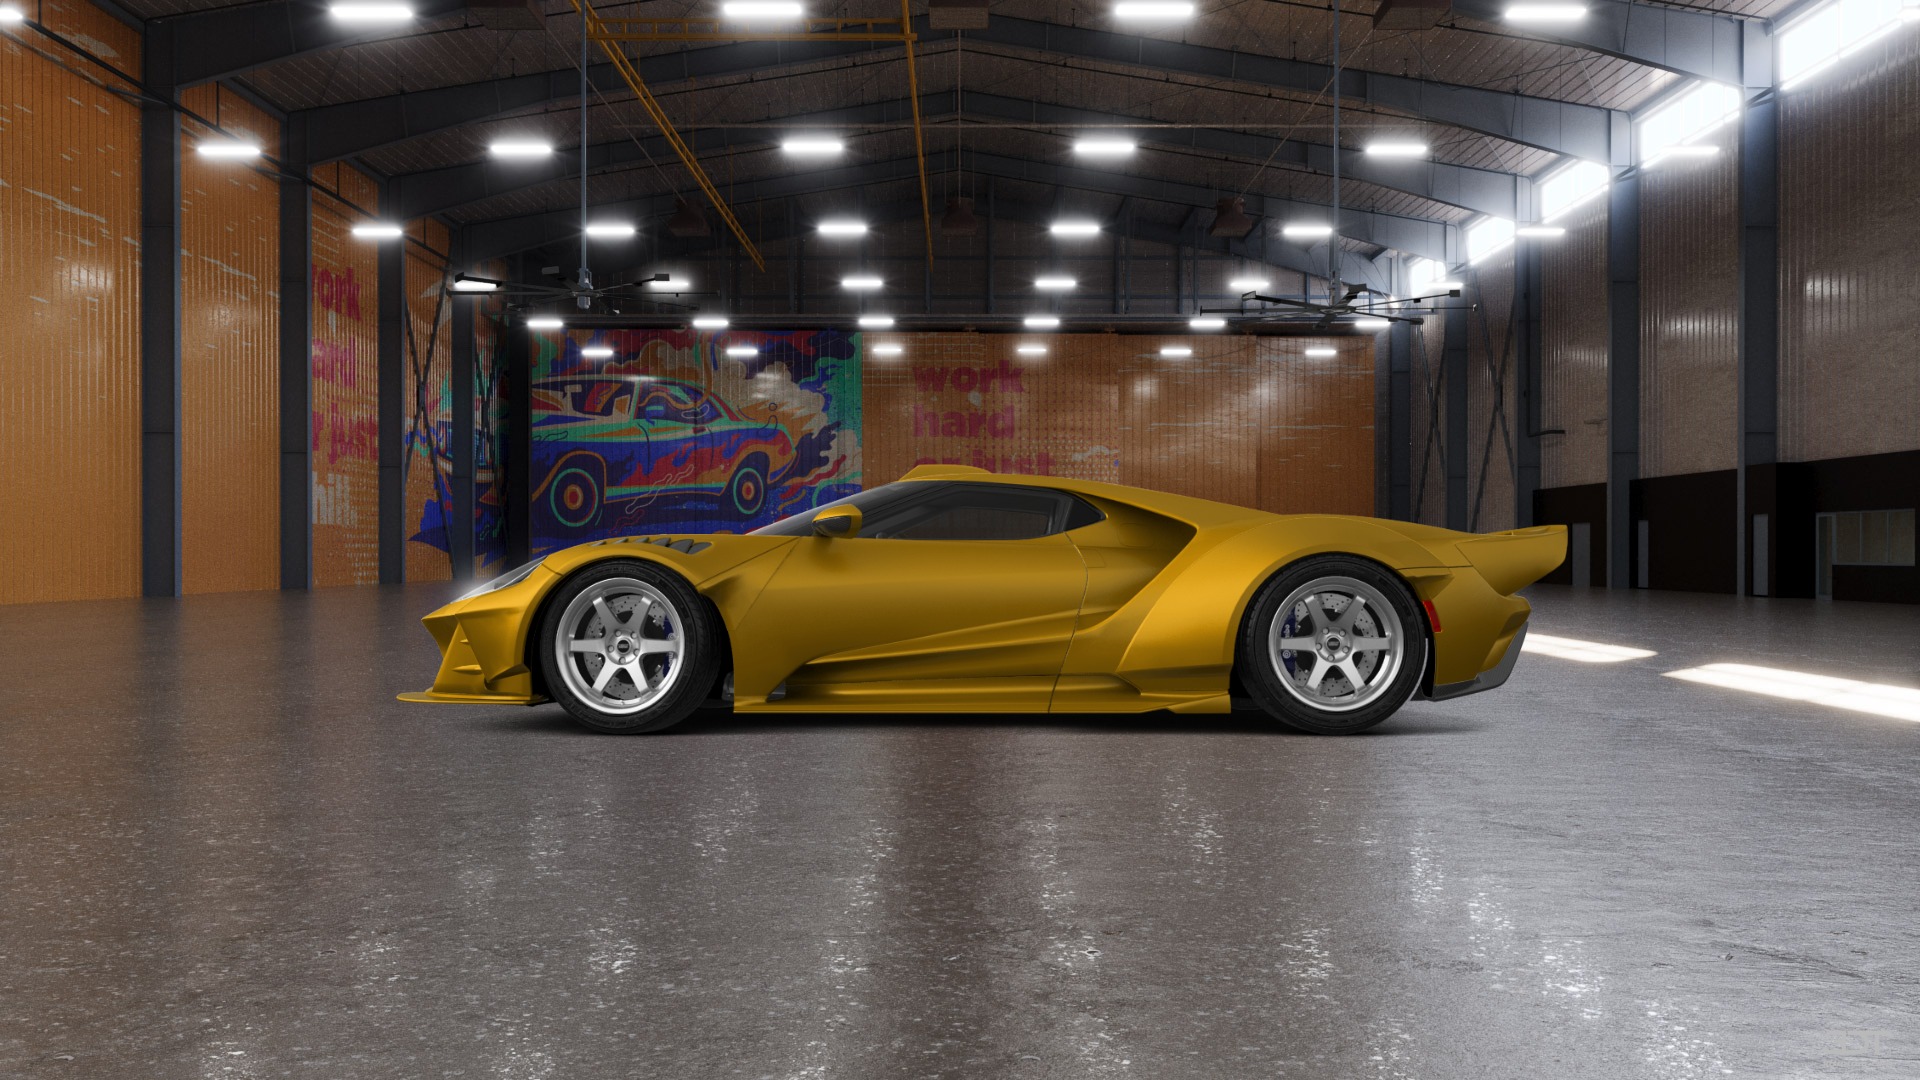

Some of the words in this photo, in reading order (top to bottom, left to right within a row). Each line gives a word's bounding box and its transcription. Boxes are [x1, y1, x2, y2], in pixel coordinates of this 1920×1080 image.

[312, 264, 361, 321] ork
[912, 360, 1025, 393] work
[328, 402, 378, 464] just
[913, 404, 1015, 439] hard
